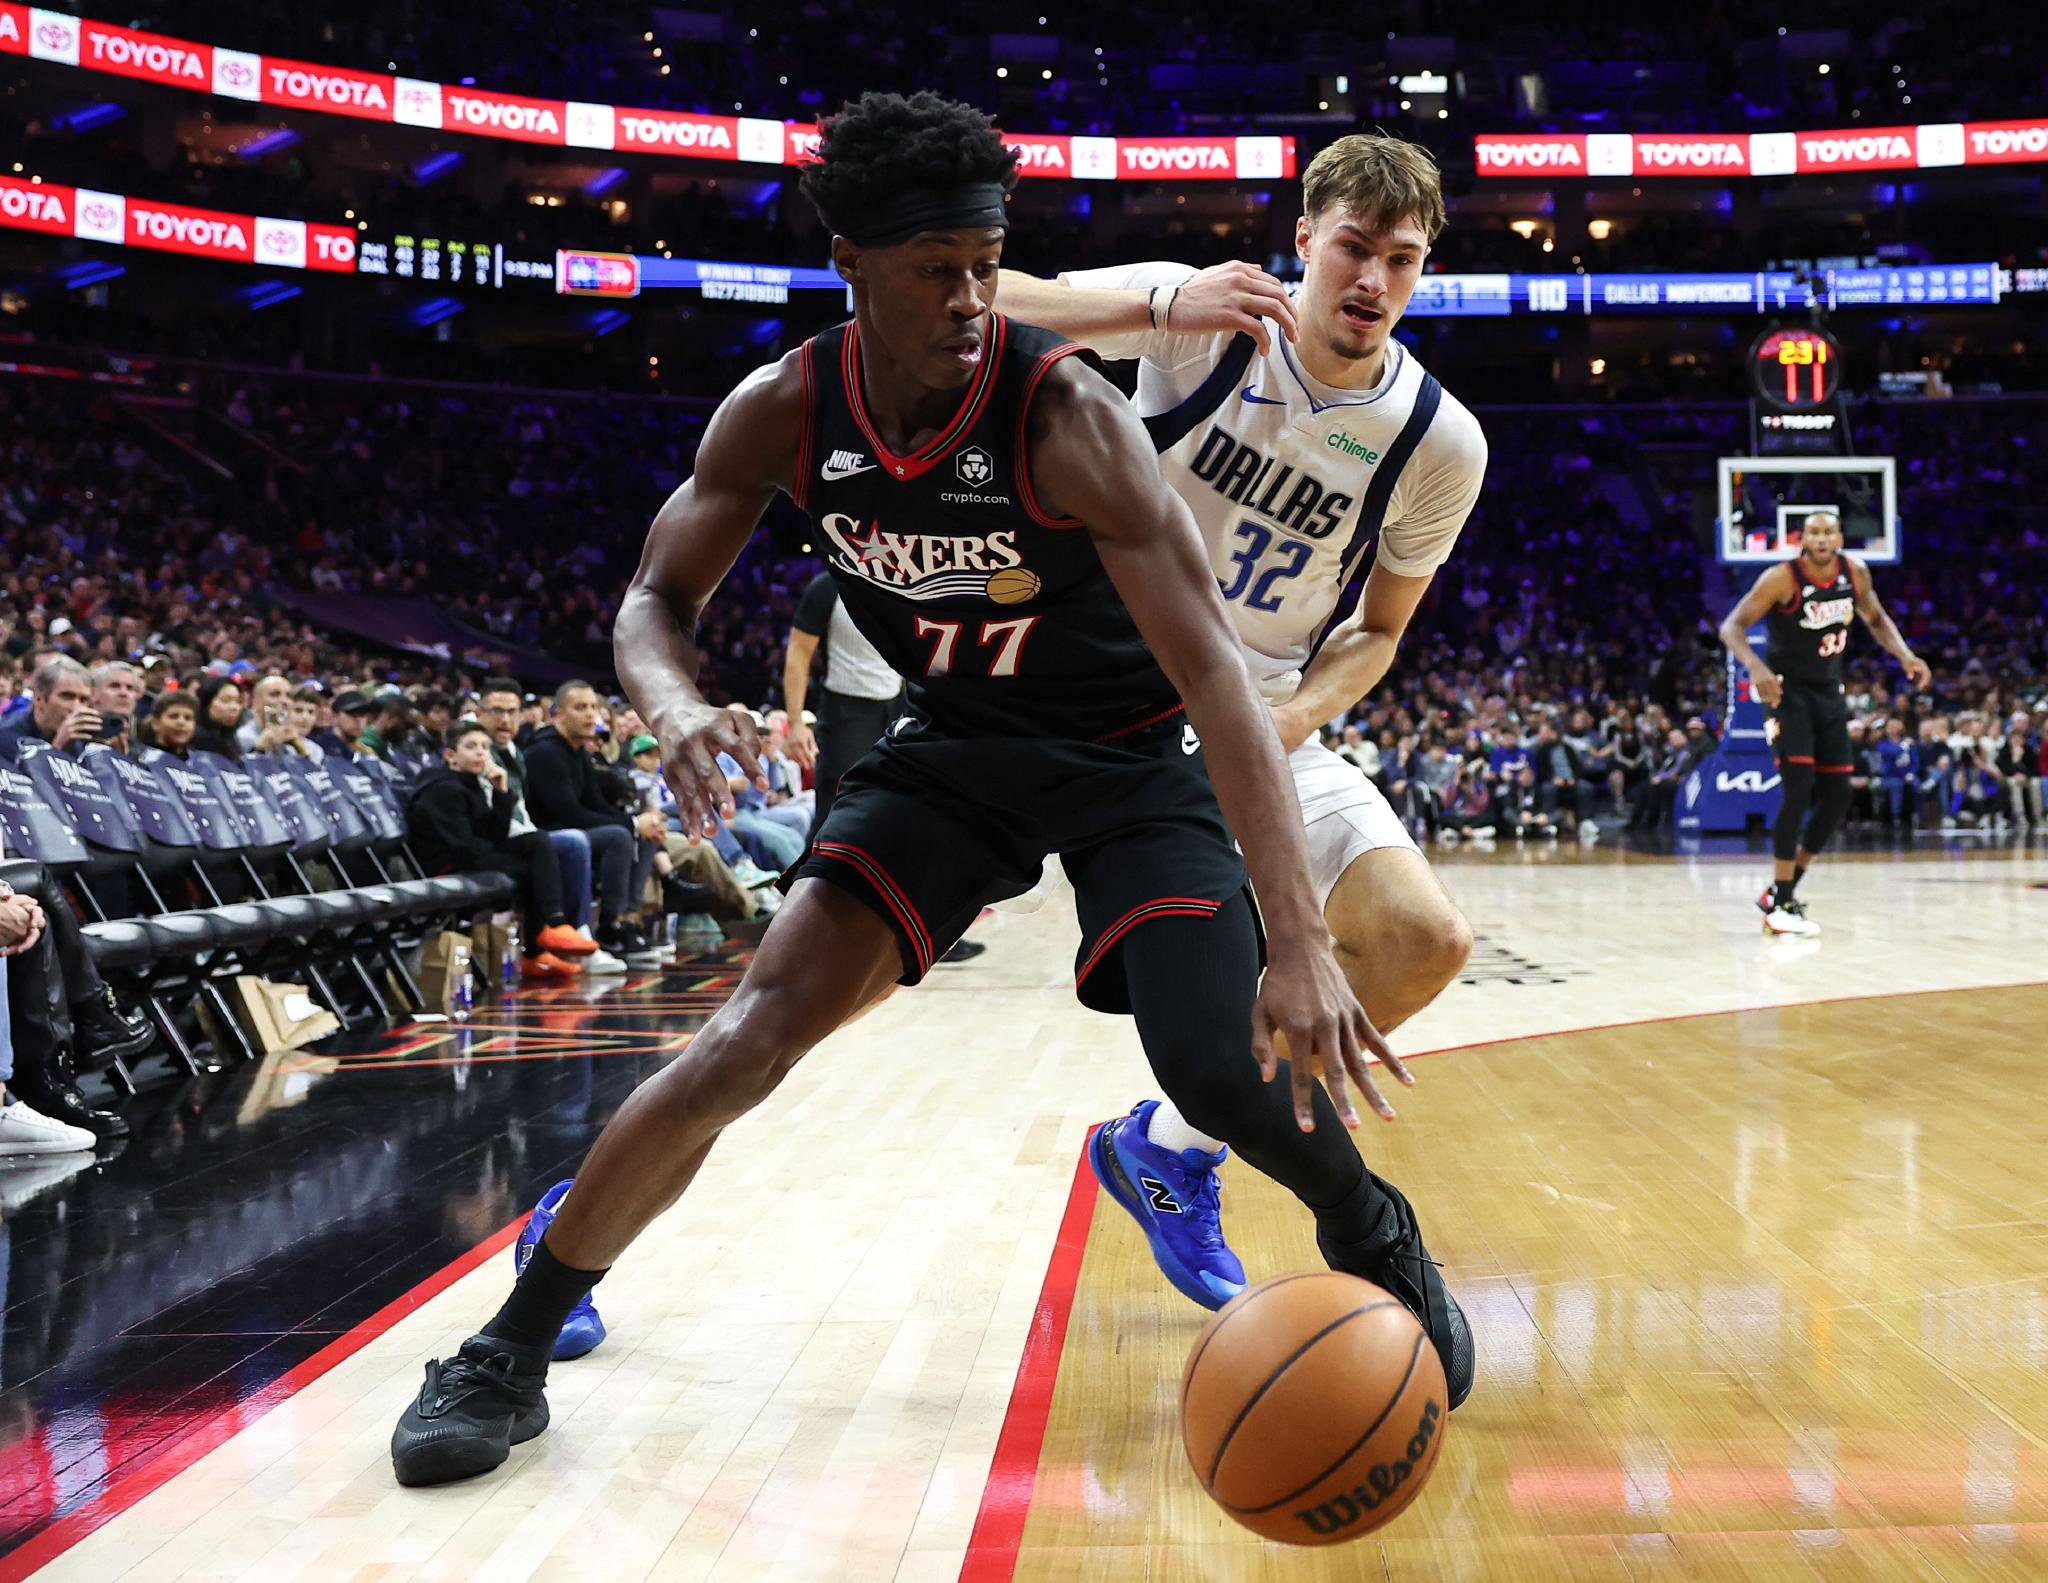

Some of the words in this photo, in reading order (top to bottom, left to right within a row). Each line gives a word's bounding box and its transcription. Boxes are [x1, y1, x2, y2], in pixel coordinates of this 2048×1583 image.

[89, 31, 205, 80] TOYOTA
[269, 67, 387, 110] TOYOTA
[448, 95, 560, 135] TOYOTA
[620, 116, 731, 149] TOYOTA
[1006, 141, 1066, 169] OTA
[1121, 145, 1230, 171] TOYOTA
[1476, 142, 1582, 168] TOYOTA
[1636, 141, 1746, 167] TOYOTA
[1801, 135, 1913, 164] TOYOTA
[1969, 127, 2048, 155] TOYO
[0, 186, 67, 224] OTA
[133, 209, 248, 252] TOYOTA
[1604, 282, 1660, 305] DALLAS
[1665, 282, 1752, 304] MAVERICKS
[1786, 362, 1824, 403] 11
[828, 449, 865, 470] NIKE
[1327, 432, 1379, 465] chime
[940, 491, 1010, 505] crypto.com
[1190, 422, 1354, 540] DALLAS
[821, 512, 1023, 587] SIXERS
[1215, 517, 1315, 614] 32
[914, 614, 1043, 678] 77
[1294, 1397, 1441, 1535] Wilson
